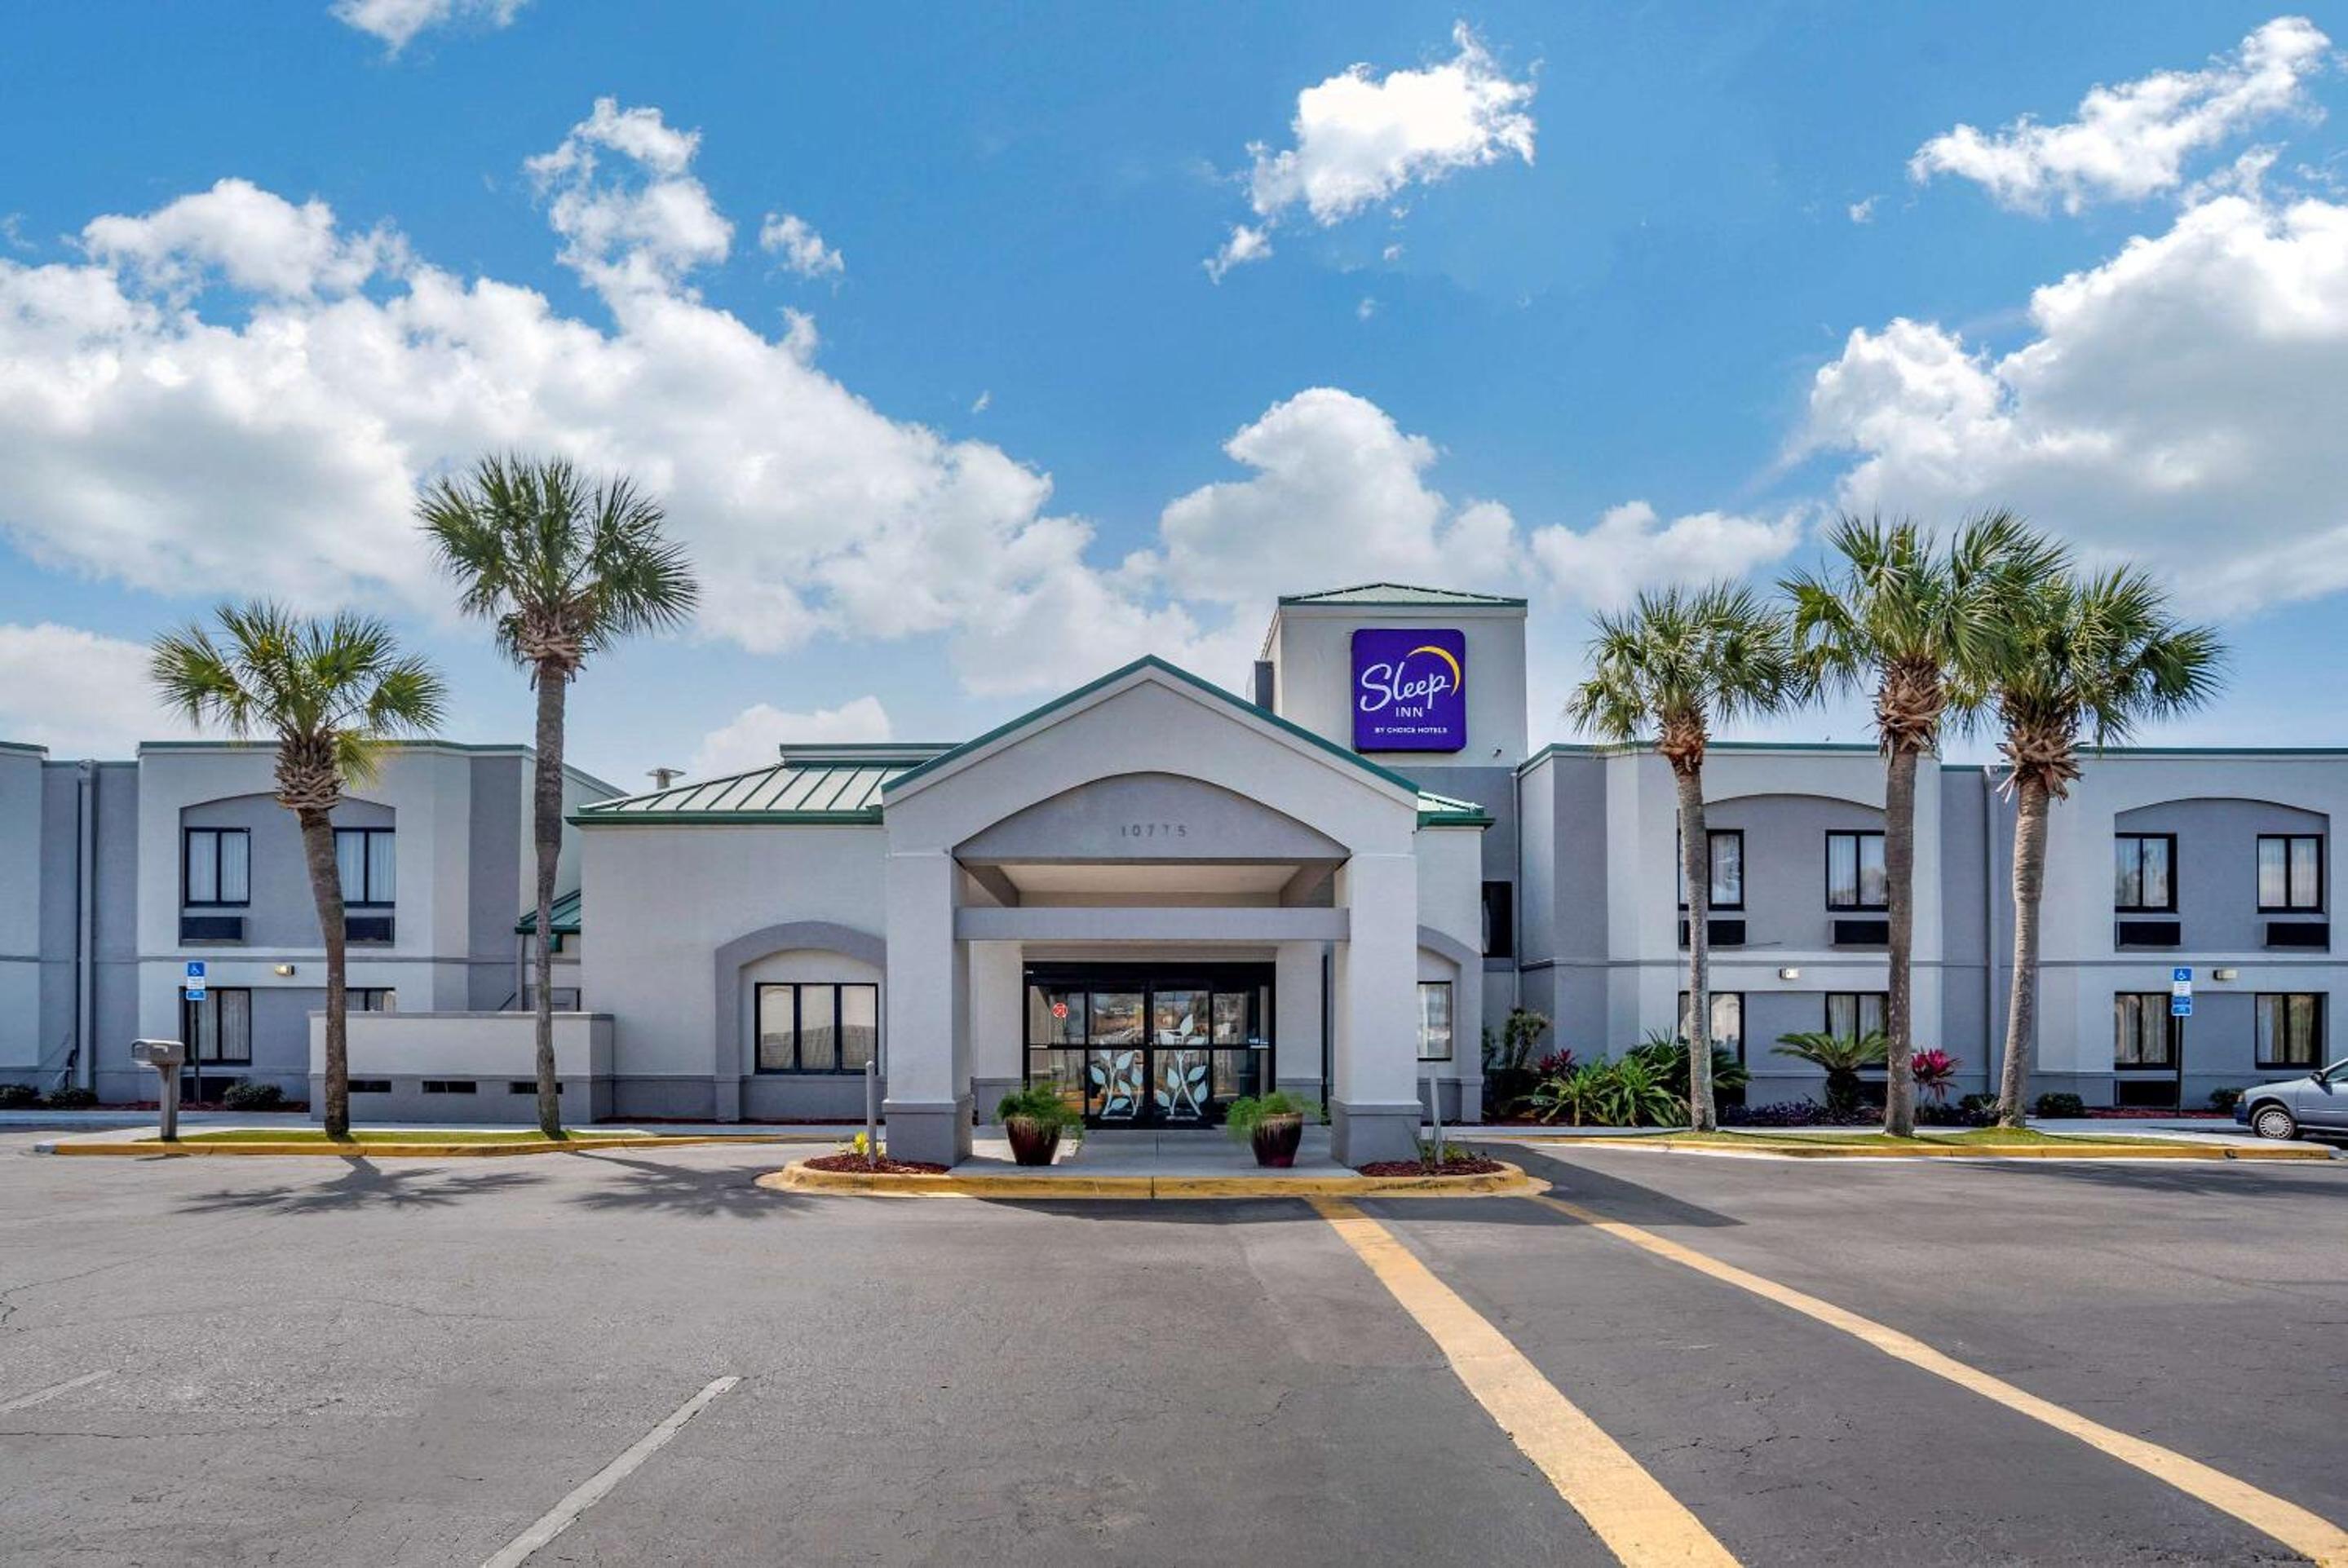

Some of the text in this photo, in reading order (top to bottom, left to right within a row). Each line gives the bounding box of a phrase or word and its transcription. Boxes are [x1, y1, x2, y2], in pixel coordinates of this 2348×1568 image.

[1360, 661, 1452, 711] Sleep
[1395, 706, 1423, 718] INN
[1121, 823, 1187, 837] 10775
